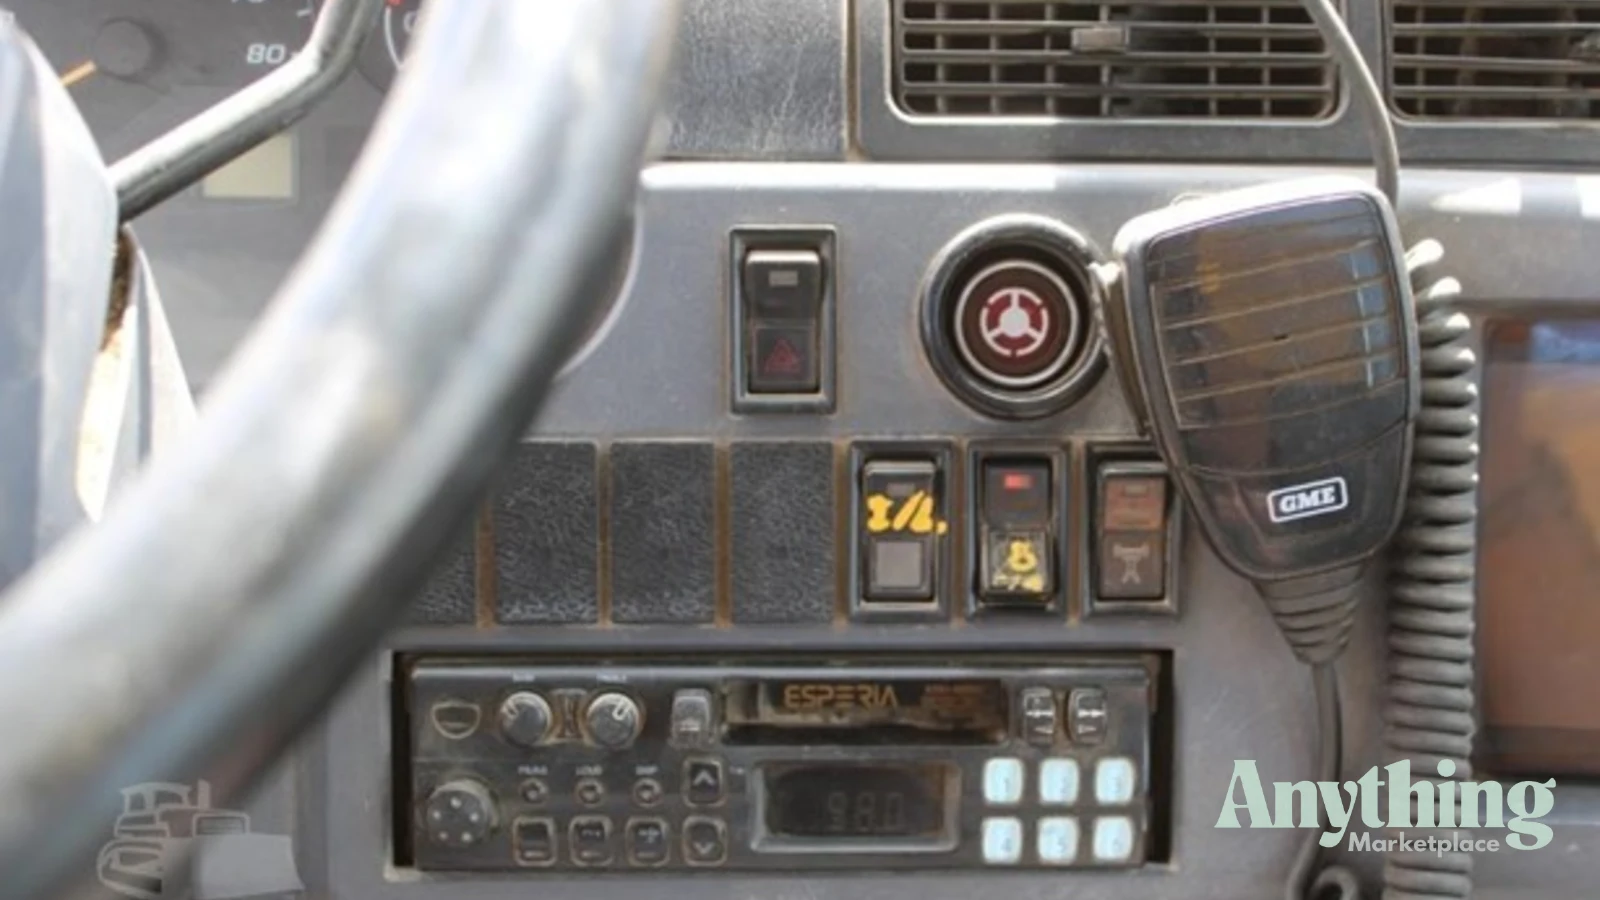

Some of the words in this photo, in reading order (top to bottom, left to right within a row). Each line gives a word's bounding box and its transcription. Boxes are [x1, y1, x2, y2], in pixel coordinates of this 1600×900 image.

[247, 43, 286, 64] 80
[1280, 486, 1336, 513] GME
[784, 685, 899, 710] ESPERIA
